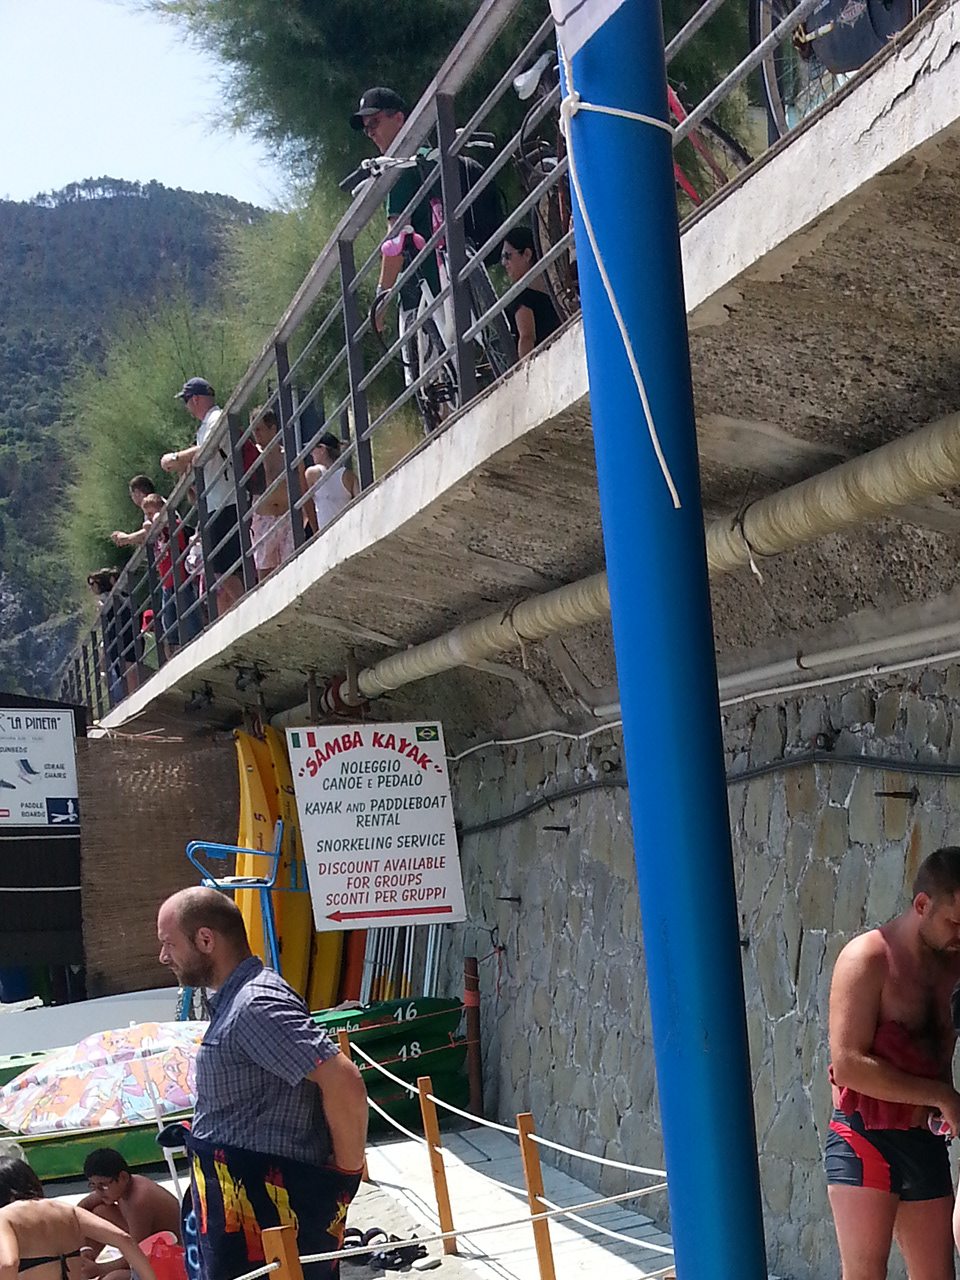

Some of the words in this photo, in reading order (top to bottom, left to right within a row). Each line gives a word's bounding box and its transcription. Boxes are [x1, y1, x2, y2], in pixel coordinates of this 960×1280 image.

[340, 759, 401, 775] NOLEGGIO
[322, 776, 362, 791] CANOE
[377, 771, 423, 789] PEDALÒ
[305, 801, 342, 815] KAYAK
[345, 802, 366, 813] AND
[370, 795, 448, 812] PADDLEBOAT
[356, 814, 401, 828] RENTAL
[317, 836, 393, 853] SNORKELING
[397, 833, 446, 849] SERVICE
[318, 860, 381, 875] DISCOUNT
[384, 856, 446, 872] AVAILABLE
[347, 876, 370, 890] FOR
[374, 873, 422, 888] GROUPS
[326, 891, 370, 906] SCONTI
[375, 889, 398, 904] PER
[402, 887, 447, 902] GRUPPI
[393, 1002, 418, 1023] 16
[398, 1041, 422, 1062] 18
